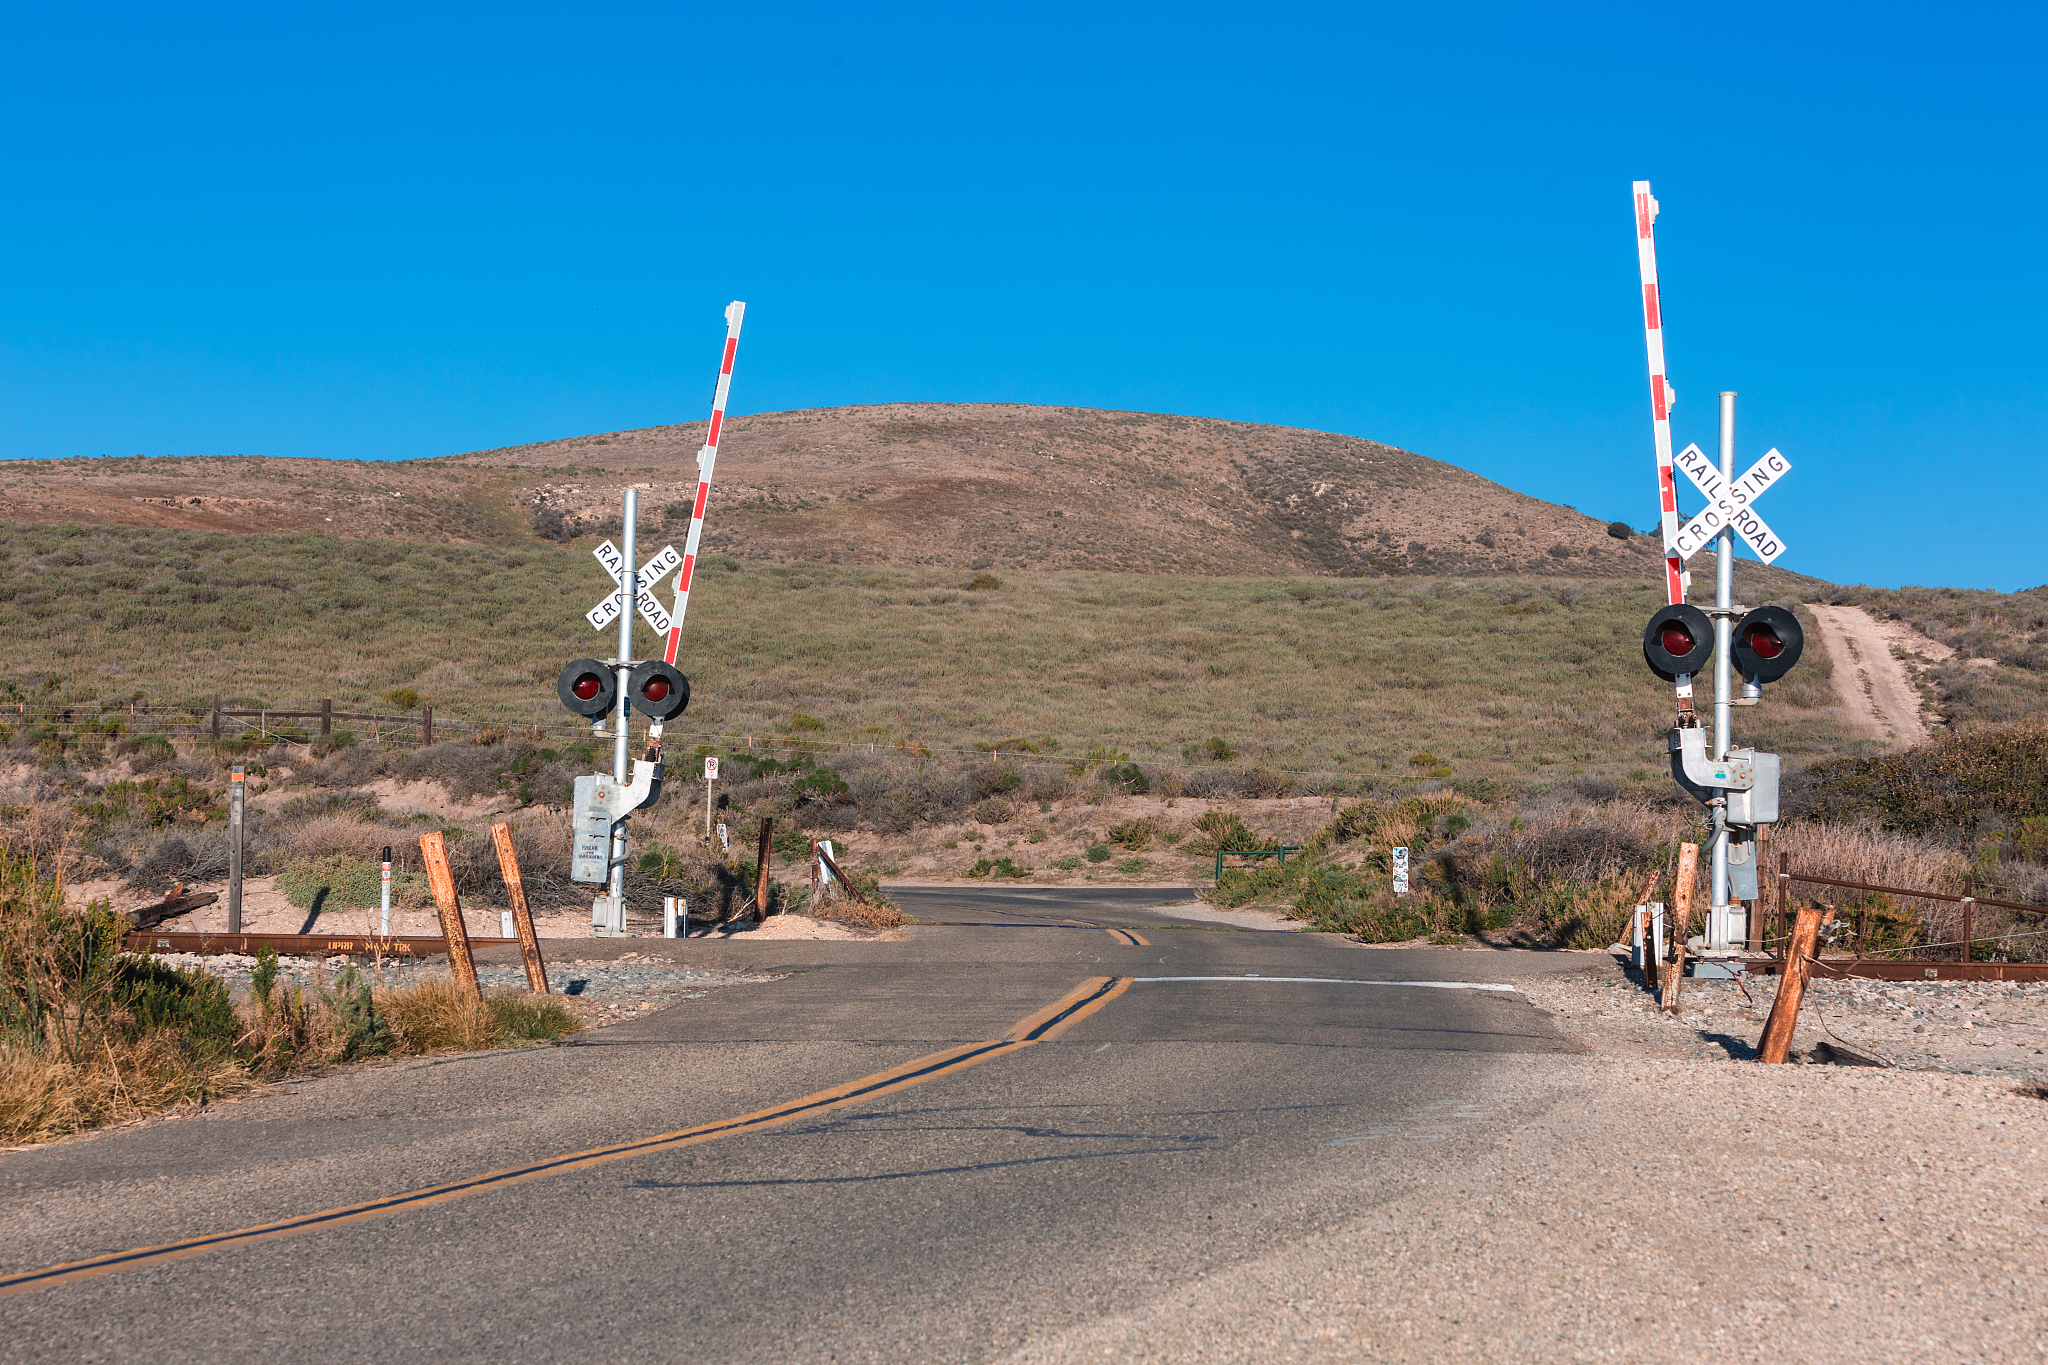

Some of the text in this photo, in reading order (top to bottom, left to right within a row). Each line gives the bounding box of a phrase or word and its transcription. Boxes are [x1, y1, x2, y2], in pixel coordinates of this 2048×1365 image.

[1677, 456, 1783, 552] CROSSING
[1680, 449, 1777, 557] RAIL ROAD
[598, 545, 669, 630] RAI ROAD
[328, 941, 353, 950] UPRR
